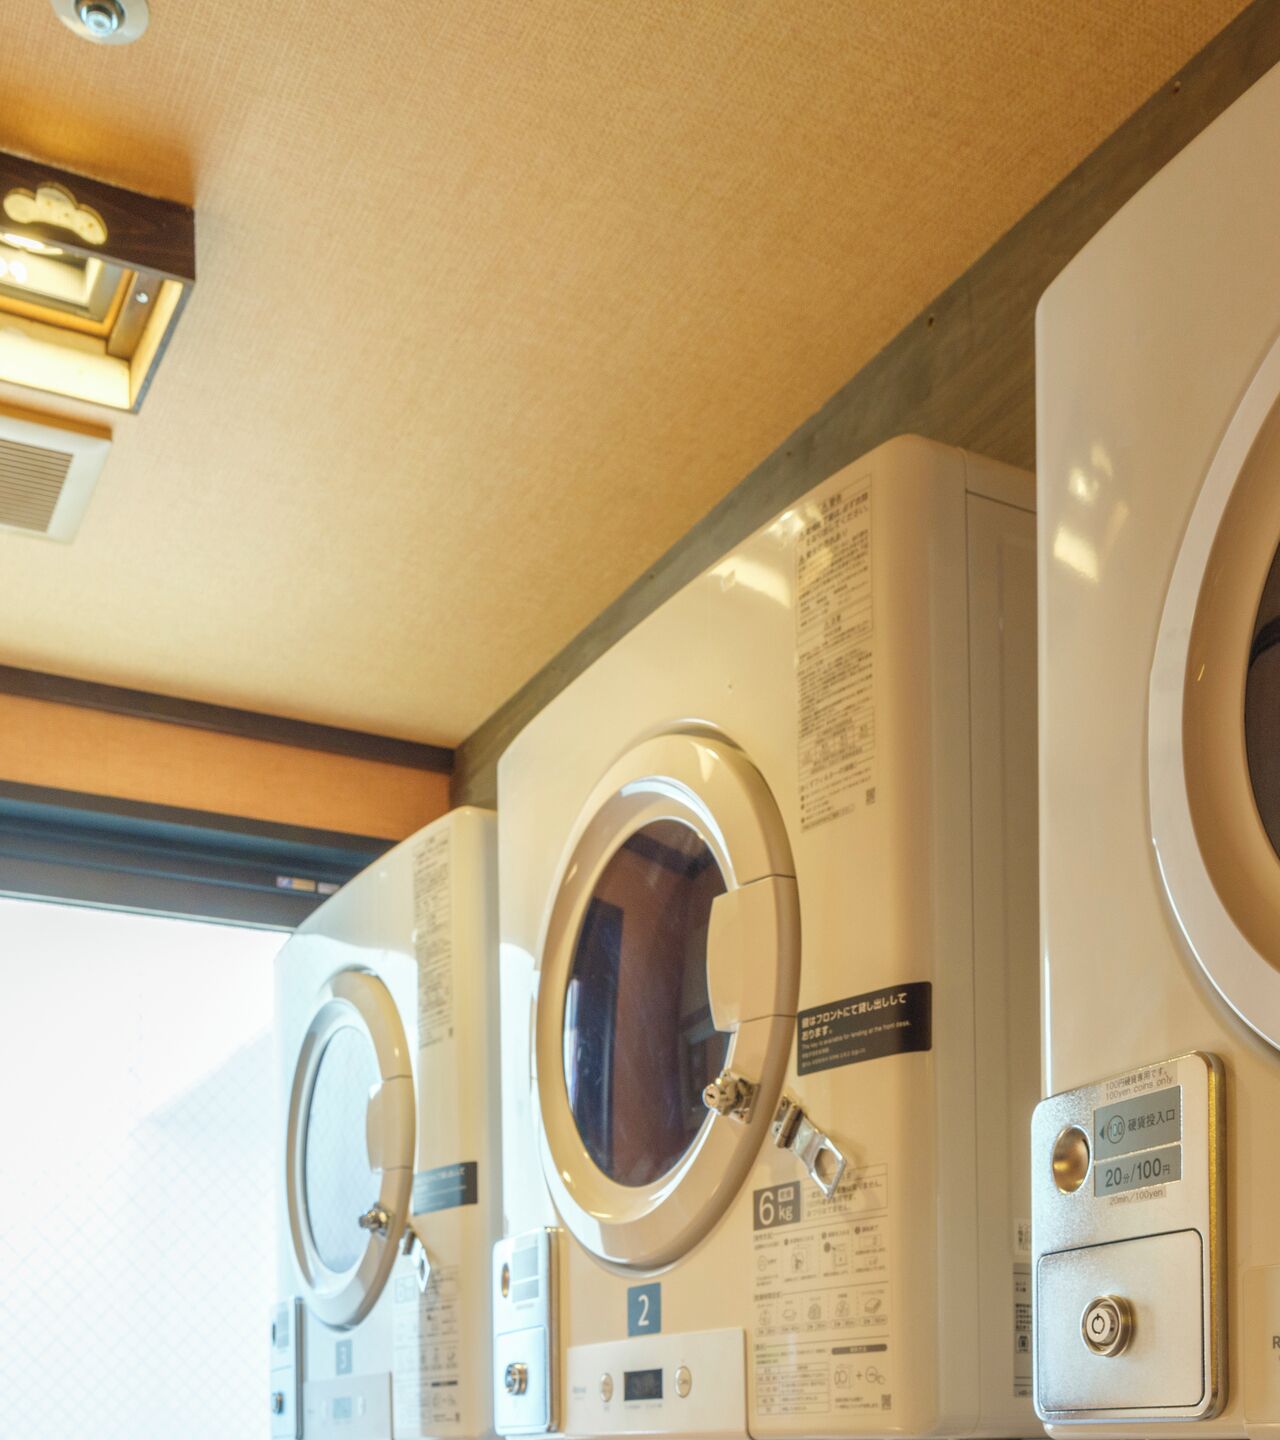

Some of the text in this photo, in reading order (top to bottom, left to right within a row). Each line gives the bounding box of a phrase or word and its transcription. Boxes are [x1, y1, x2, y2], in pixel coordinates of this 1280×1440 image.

[1128, 1107, 1175, 1132] 硬貨投入口
[1105, 1155, 1169, 1188] 20分/100円
[759, 1191, 794, 1226] 6 kg
[638, 1294, 650, 1326] 2
